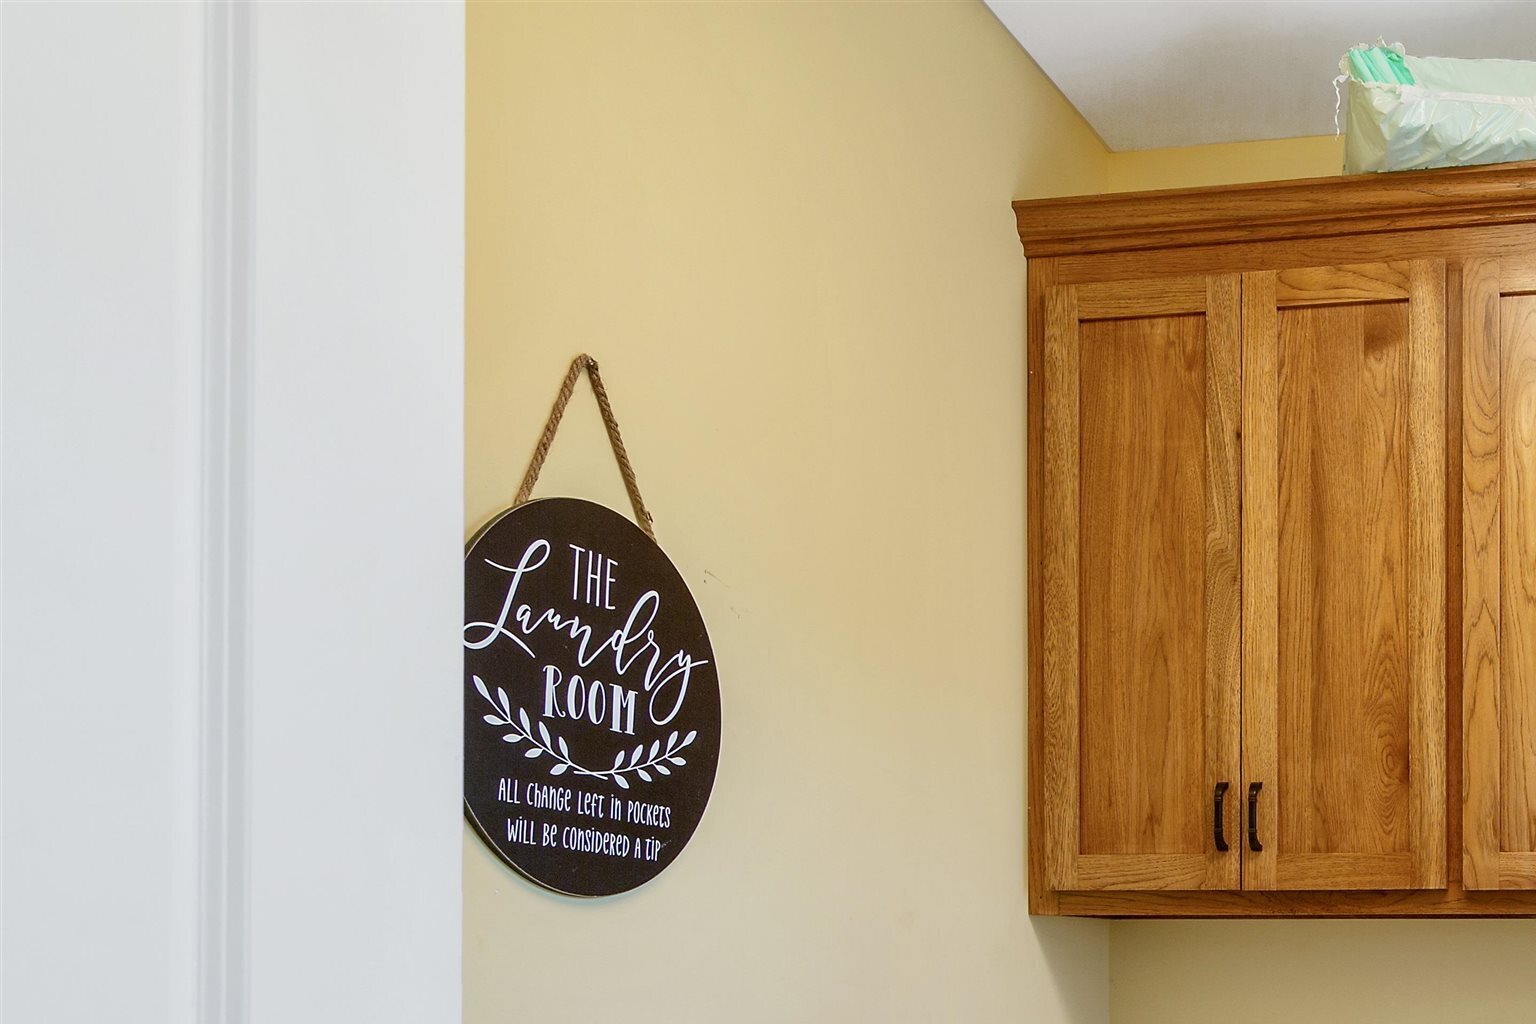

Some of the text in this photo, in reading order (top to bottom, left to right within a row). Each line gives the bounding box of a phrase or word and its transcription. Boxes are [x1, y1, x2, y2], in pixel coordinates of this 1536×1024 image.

[569, 543, 619, 610] THE
[463, 538, 709, 726] Laundry
[542, 664, 639, 737] ROOM
[498, 777, 521, 804] ALL
